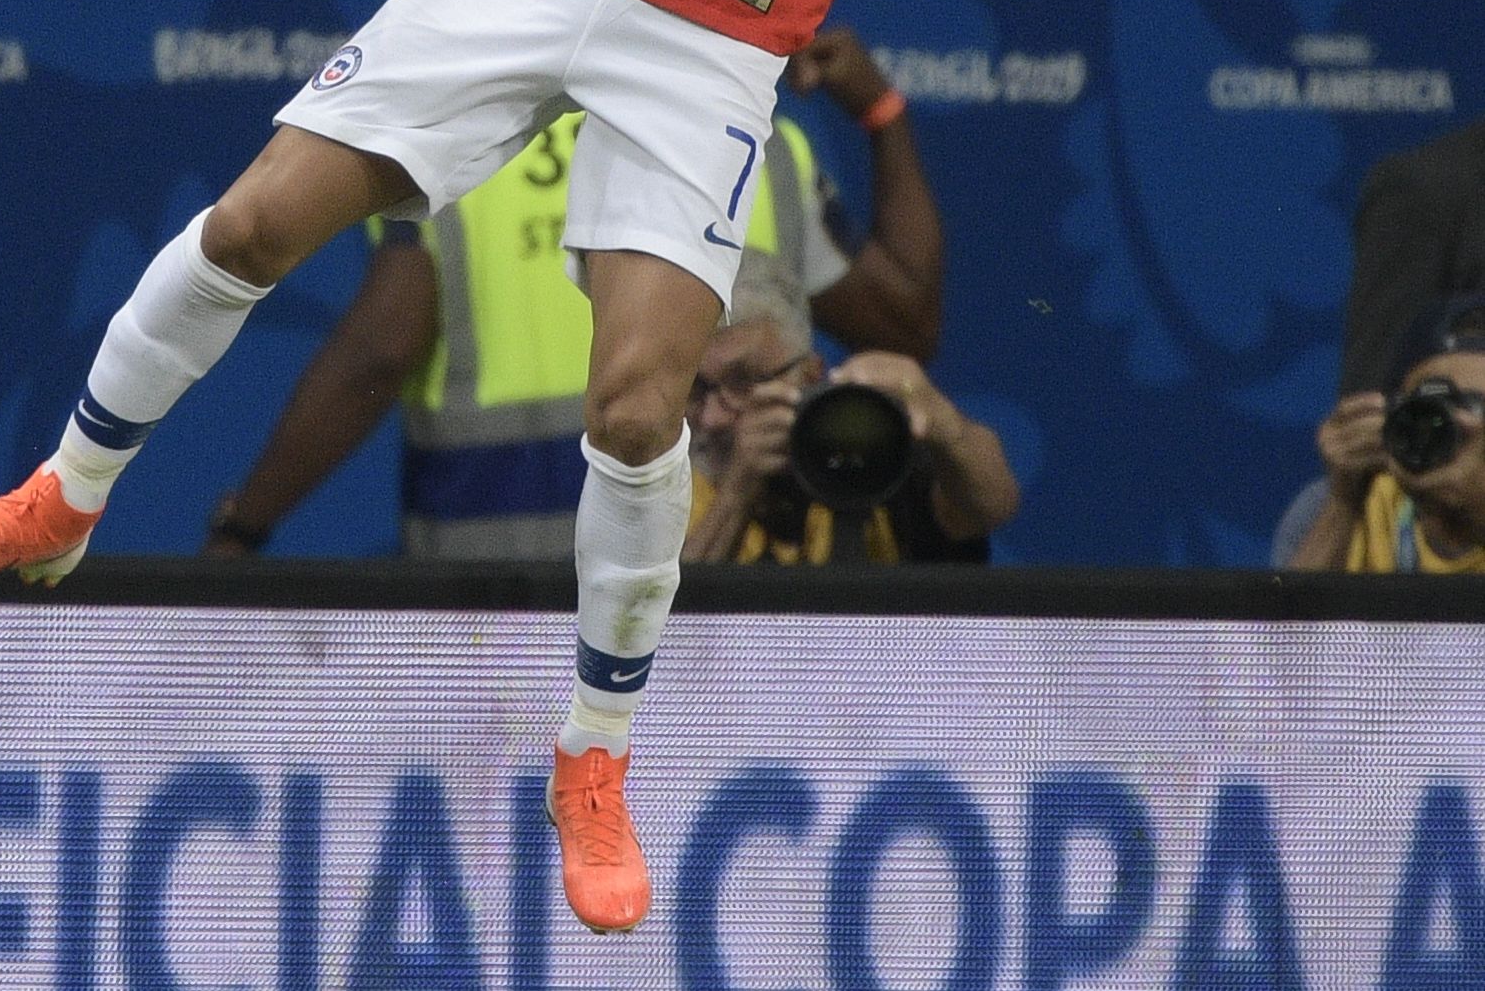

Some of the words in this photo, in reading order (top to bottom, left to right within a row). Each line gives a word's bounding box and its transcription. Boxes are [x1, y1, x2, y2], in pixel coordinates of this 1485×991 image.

[1209, 66, 1300, 110] COPA
[726, 123, 758, 221] 7
[675, 761, 1308, 991] COPA
